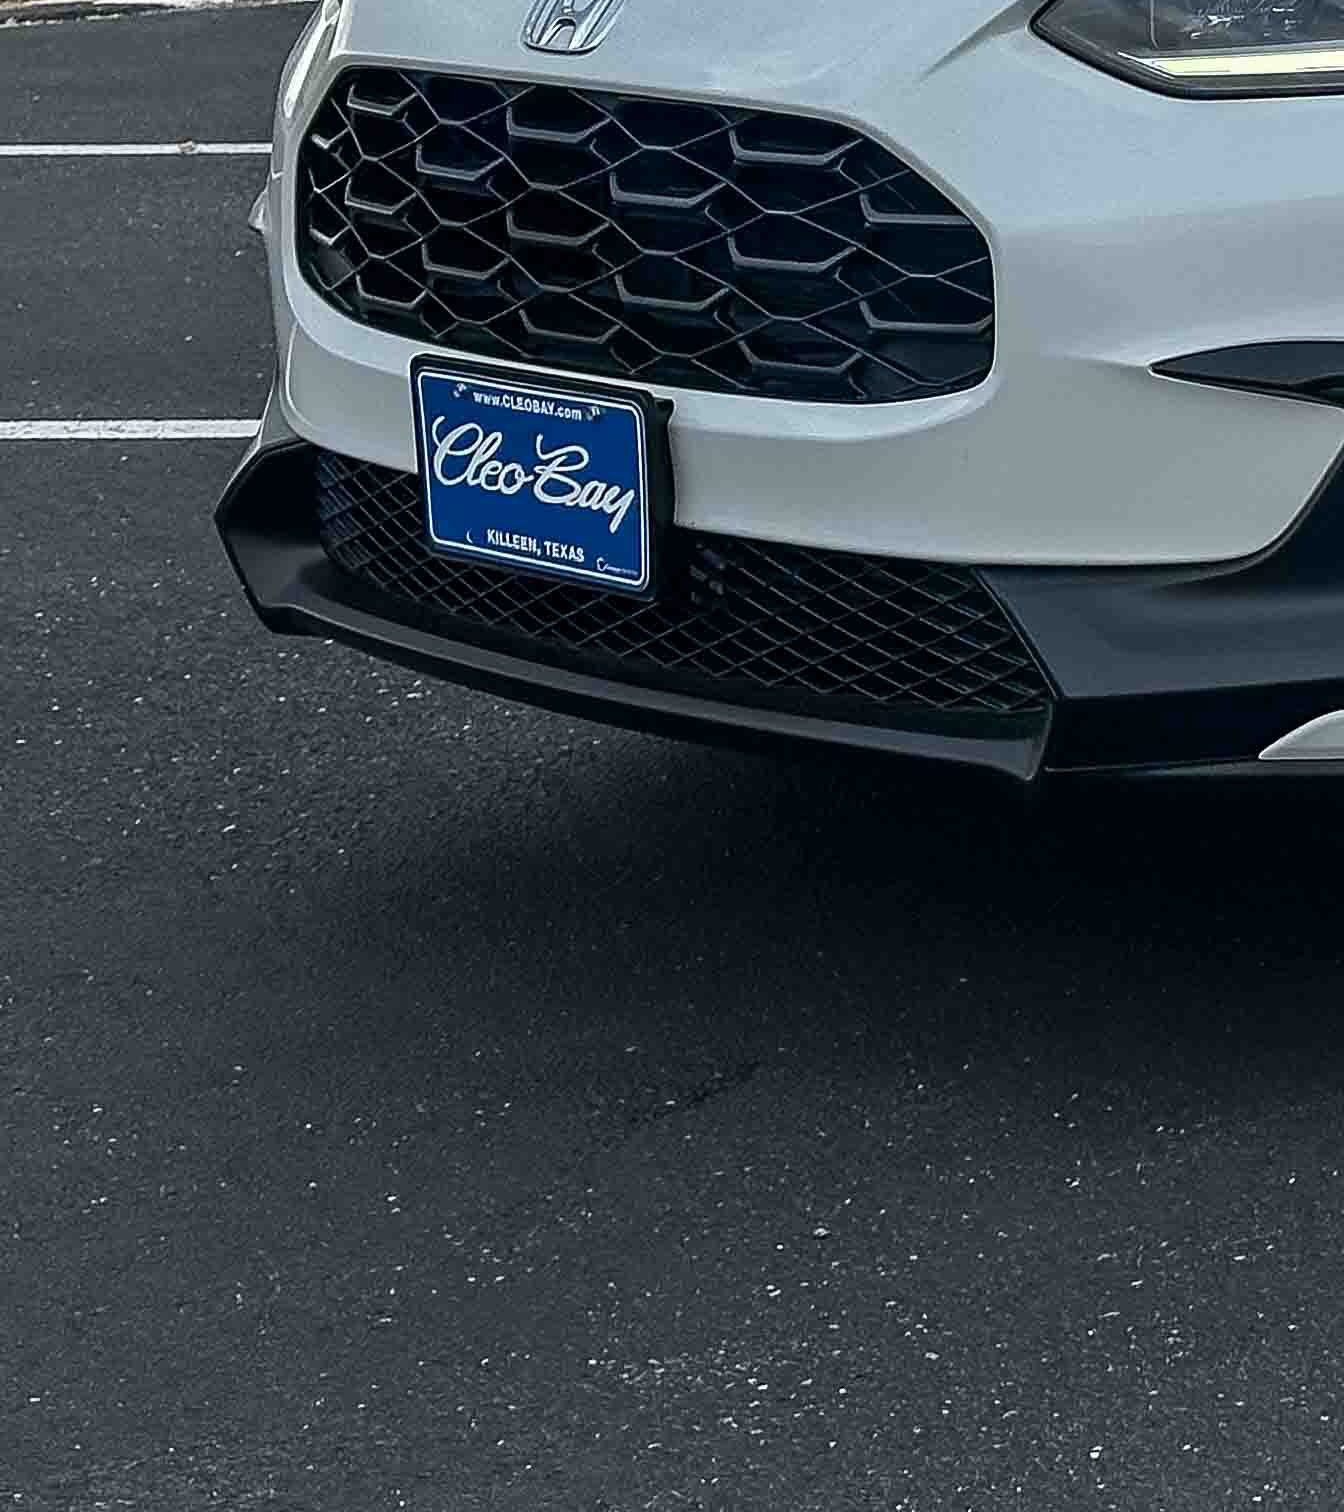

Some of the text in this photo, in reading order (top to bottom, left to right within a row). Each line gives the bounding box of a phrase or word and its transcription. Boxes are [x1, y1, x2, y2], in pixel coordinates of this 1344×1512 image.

[432, 416, 635, 534] Cleo Bay
[544, 541, 585, 563] TEXAS
